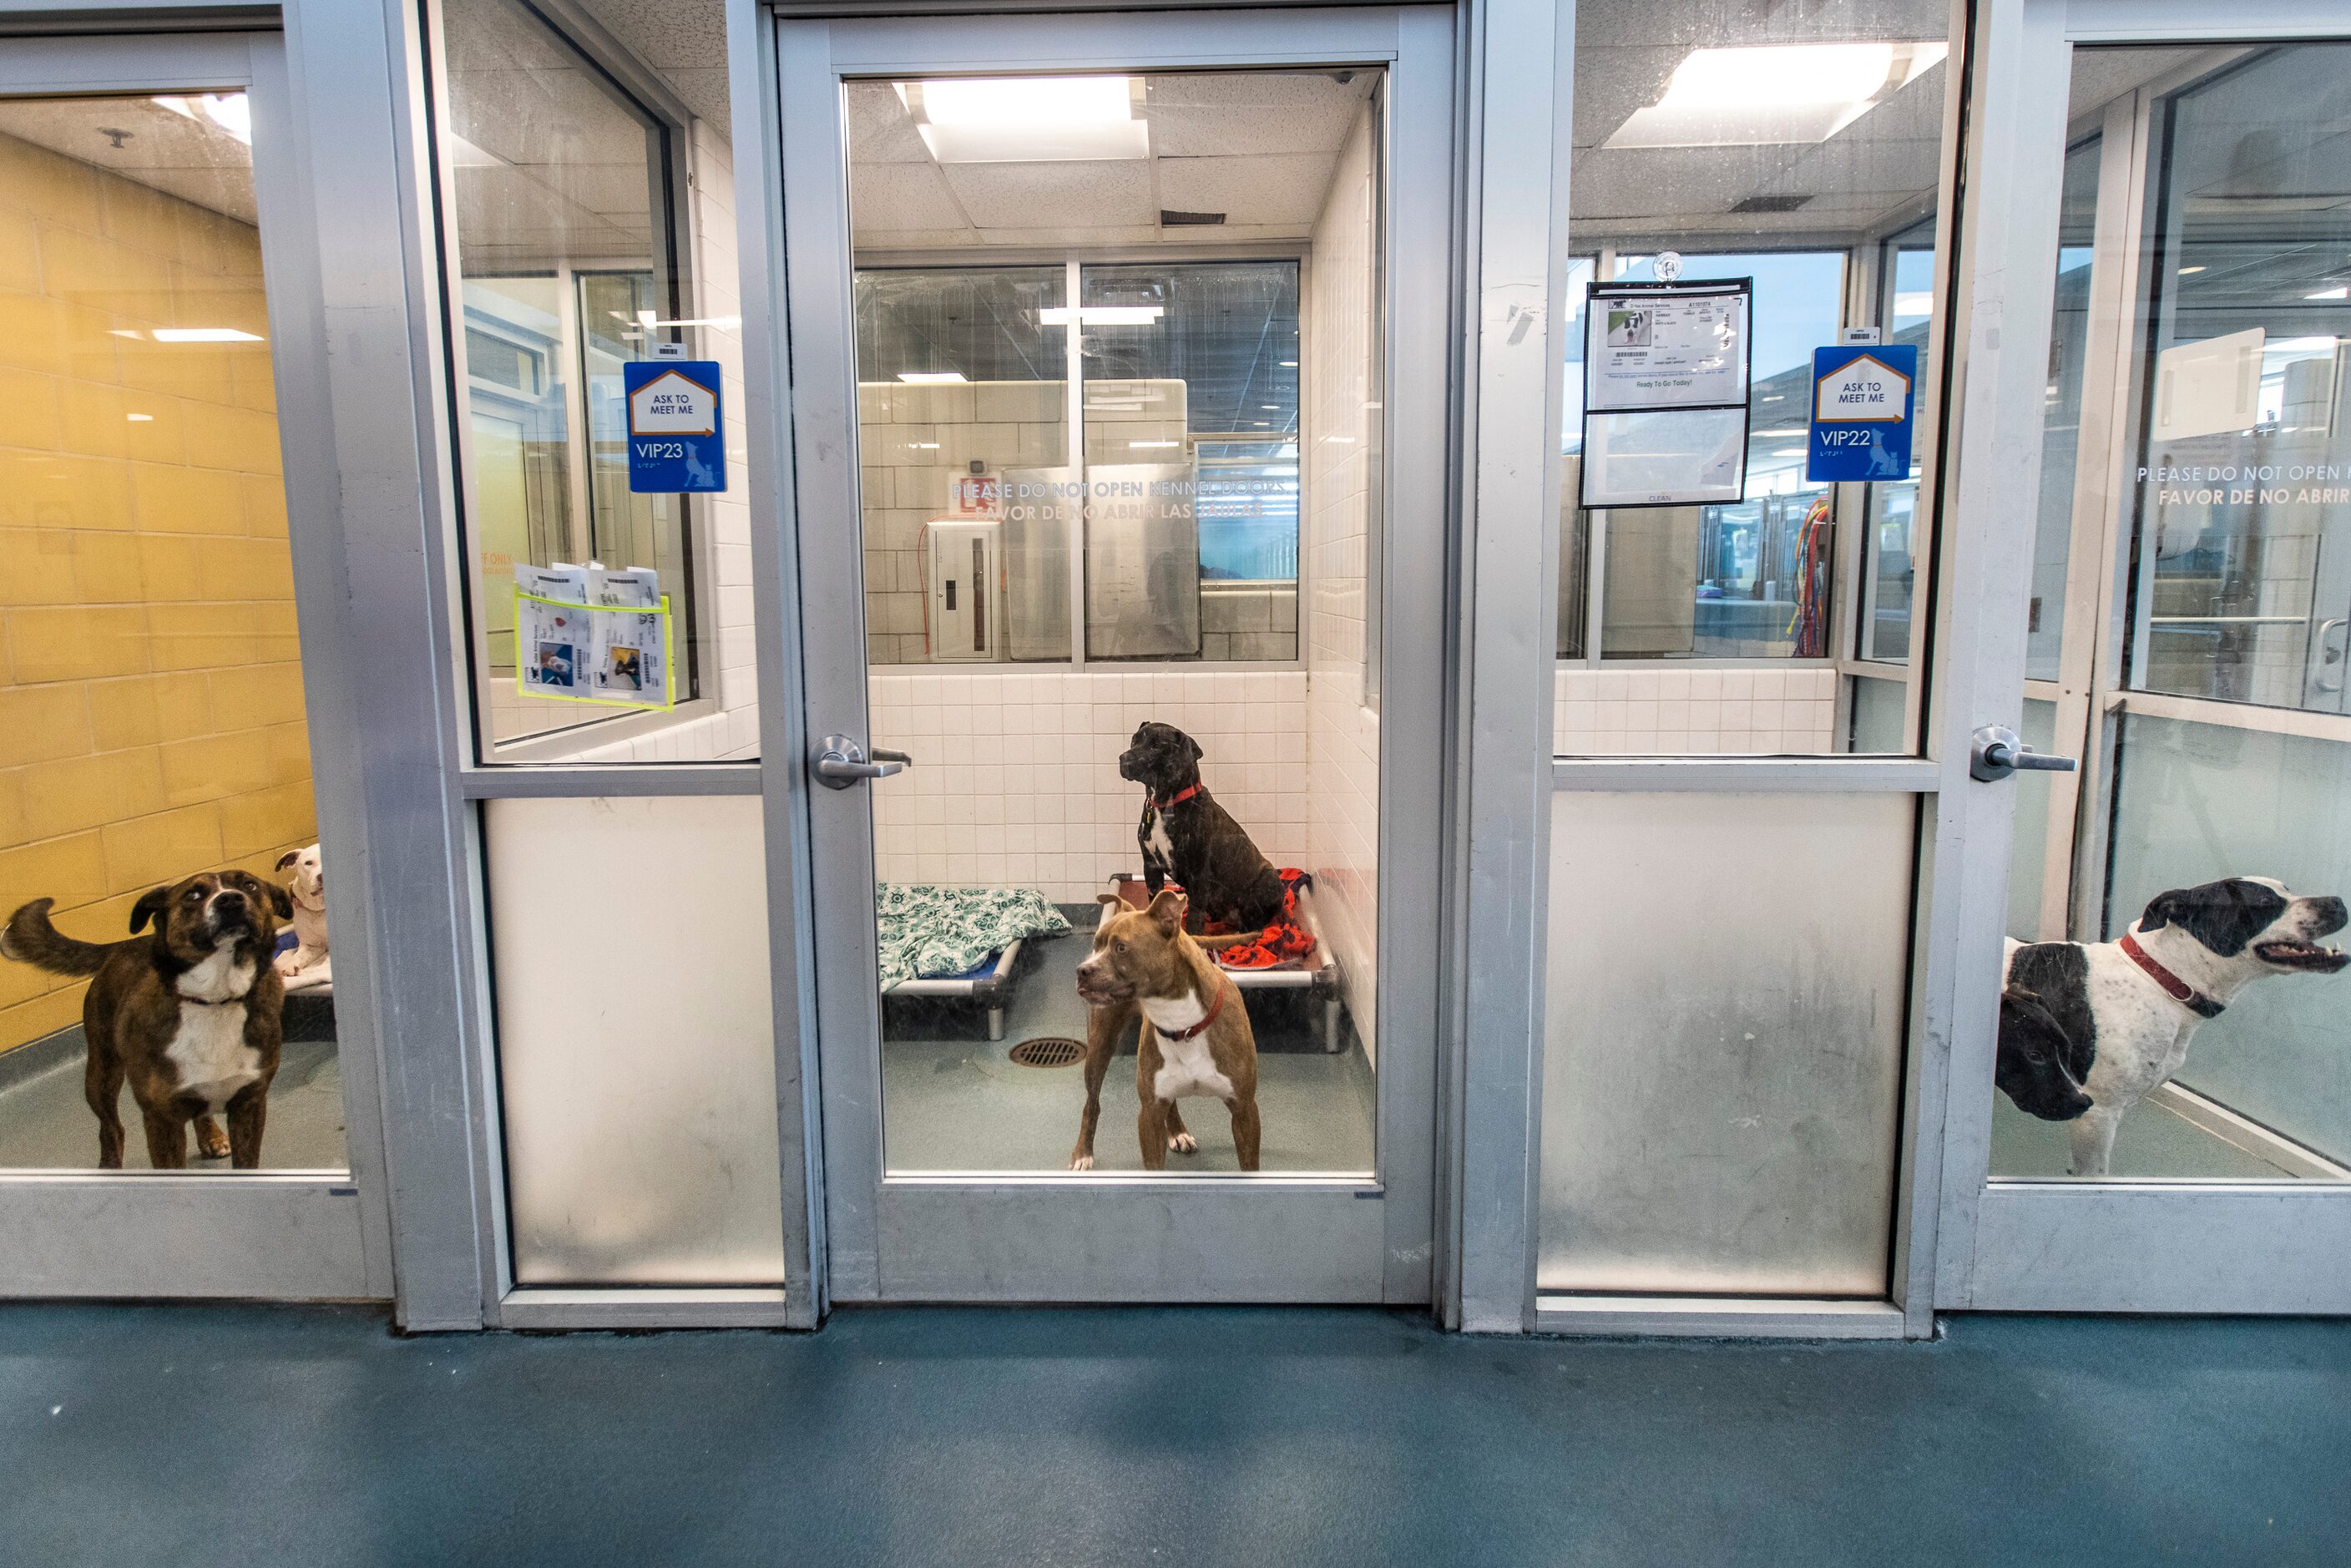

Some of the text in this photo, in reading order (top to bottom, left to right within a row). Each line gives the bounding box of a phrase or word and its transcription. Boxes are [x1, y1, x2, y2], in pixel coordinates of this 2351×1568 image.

[1673, 379, 1692, 387] Today!
[1843, 382, 1882, 392] ASK TO
[653, 395, 689, 404] ASK TO
[1838, 393, 1884, 403] MEET ME
[650, 406, 693, 414] MEET ME
[1820, 430, 1870, 447] VIP22
[636, 443, 683, 458] VIP23
[2137, 467, 2202, 482] PLEASE
[2207, 466, 2237, 482] DO
[2244, 466, 2283, 481] NOT
[2289, 465, 2340, 481] OPEN
[953, 482, 1013, 499] PLEASE
[1019, 482, 1046, 498] DO
[1052, 482, 1090, 498] NOT
[1094, 480, 1144, 498] OPEN
[1150, 480, 1217, 497] KENNEL
[2159, 488, 2350, 505] FAVOR DE NO ABRIR
[975, 504, 1036, 522] FAVOR
[1042, 504, 1064, 521] DE
[1070, 503, 1099, 520] NO
[1104, 503, 1155, 520] ABRIR
[1160, 503, 1191, 519] LAS
[490, 552, 512, 564] ONLY
